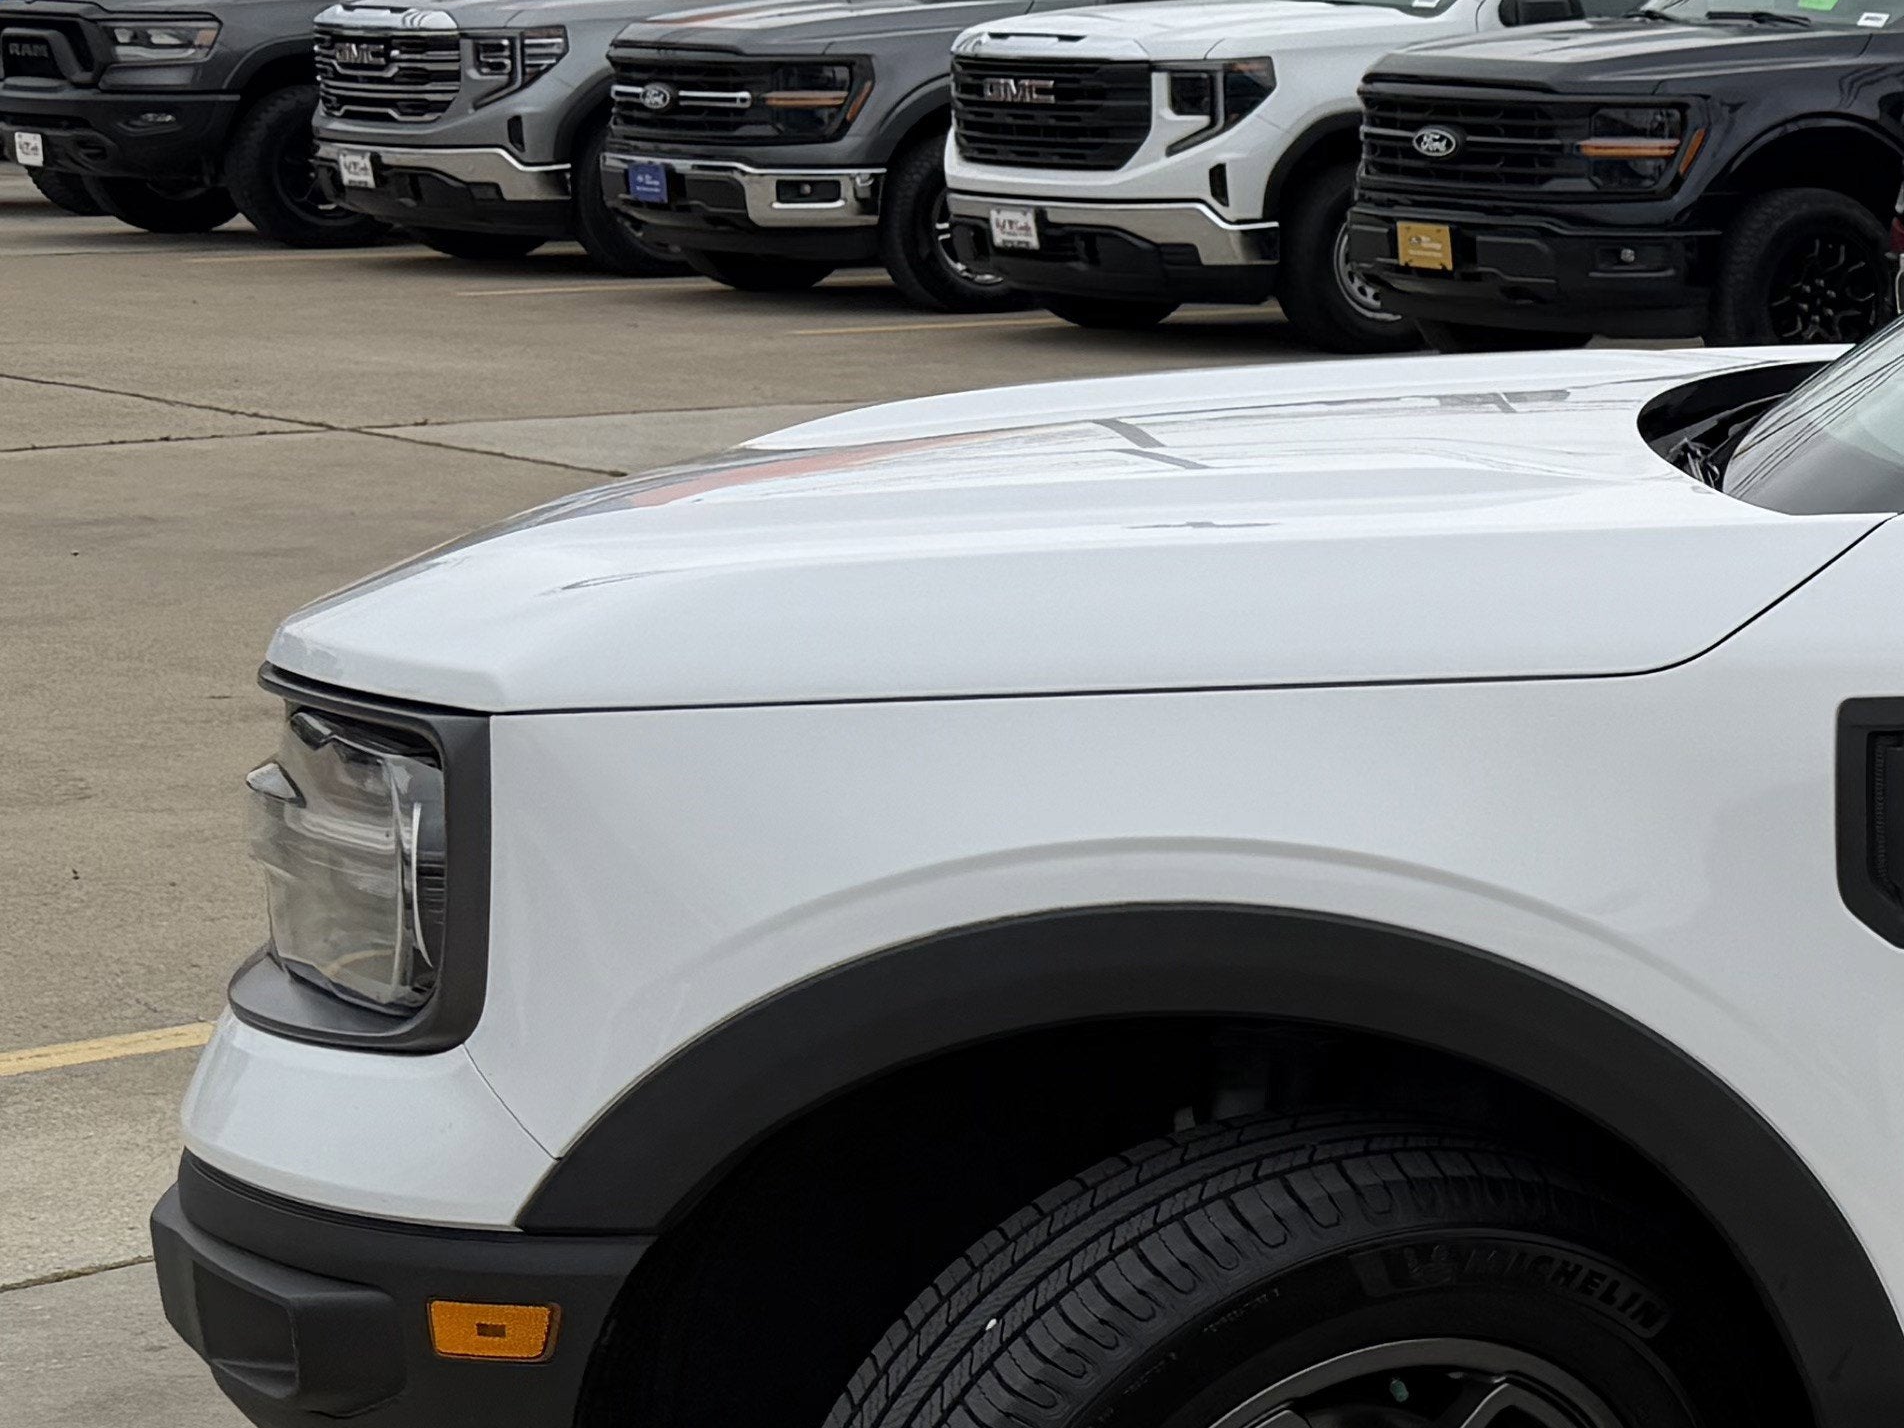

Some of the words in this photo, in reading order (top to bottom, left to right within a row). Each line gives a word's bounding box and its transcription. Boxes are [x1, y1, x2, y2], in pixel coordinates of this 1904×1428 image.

[9, 42, 49, 59] RAM
[335, 43, 386, 65] GMC
[983, 77, 1056, 104] GMC
